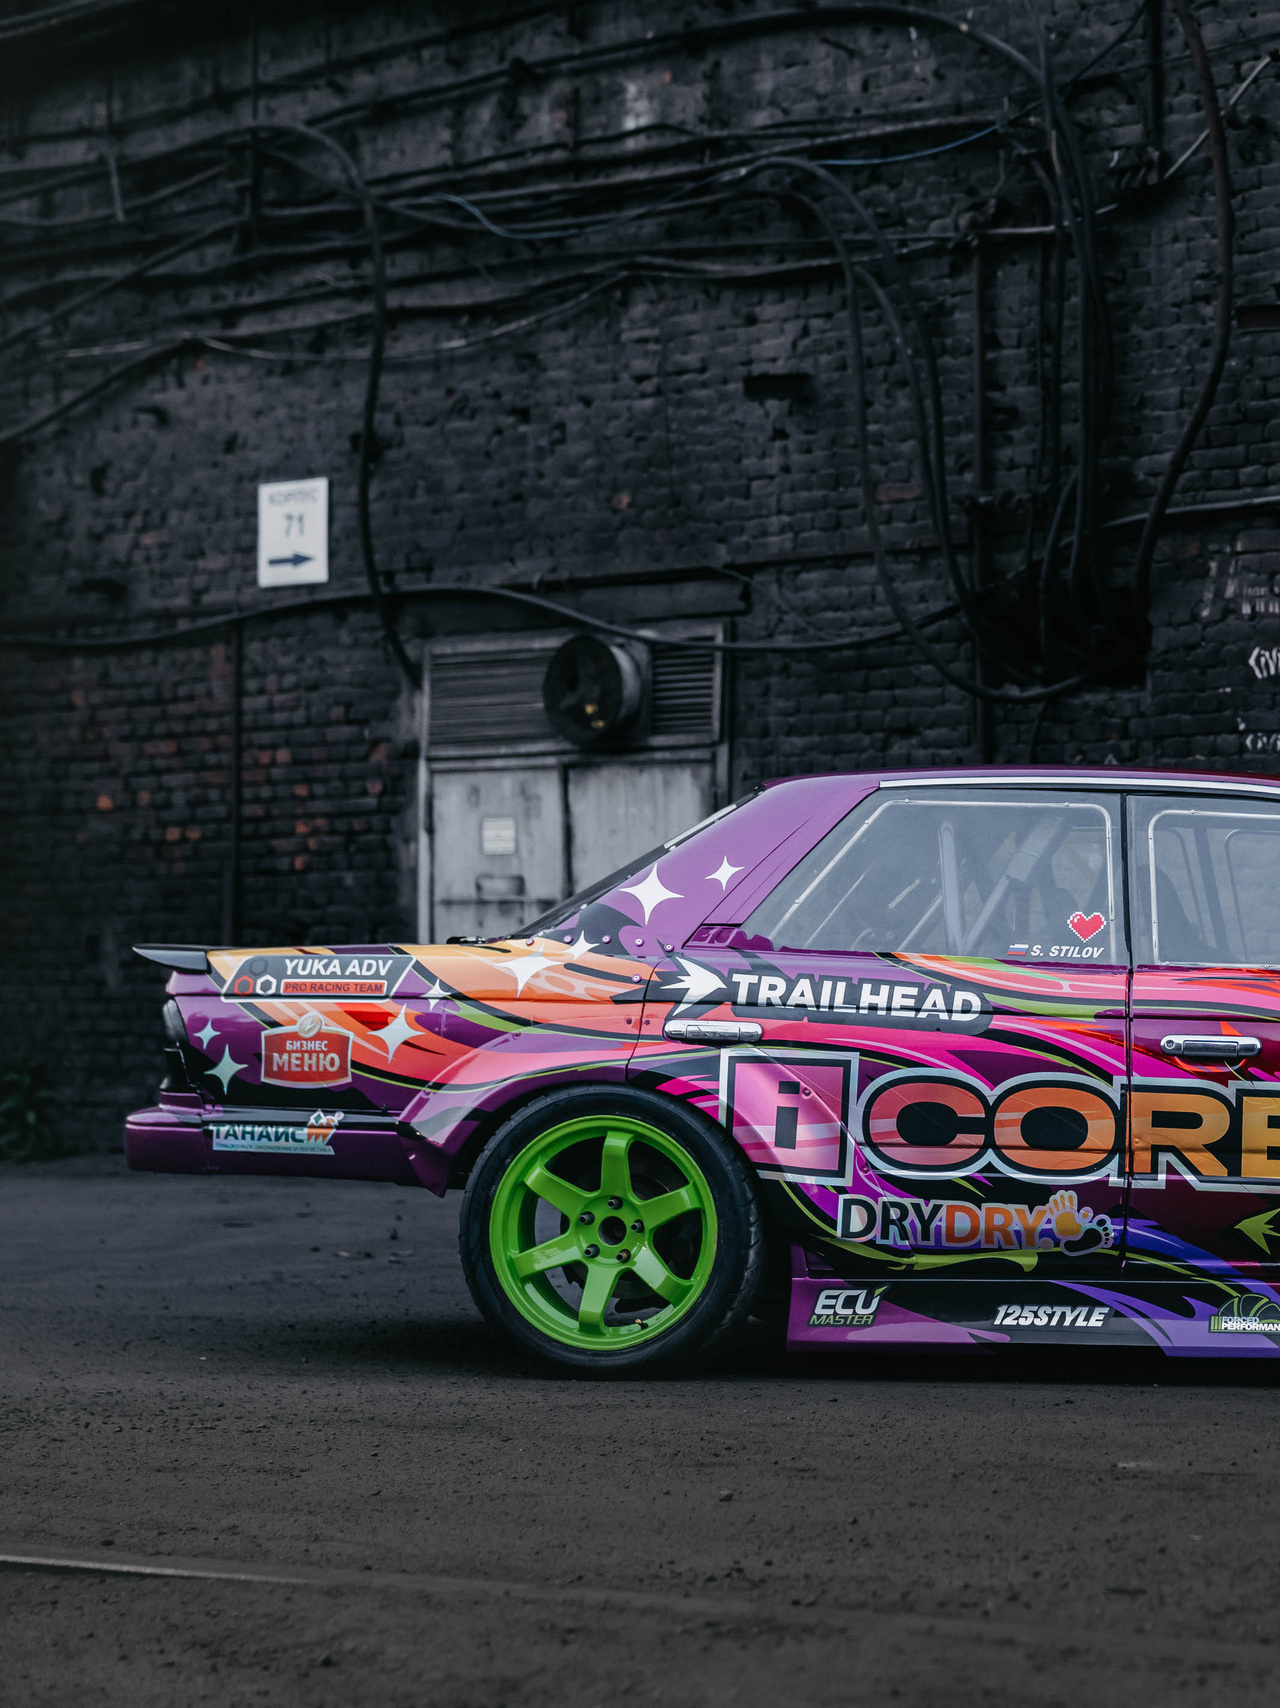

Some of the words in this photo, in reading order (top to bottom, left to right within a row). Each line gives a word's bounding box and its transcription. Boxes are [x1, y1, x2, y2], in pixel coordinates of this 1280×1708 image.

[1031, 944, 1044, 957] S.
[1049, 945, 1104, 959] STILOV
[285, 958, 342, 976] YUKA
[345, 959, 393, 976] ADV
[285, 981, 306, 993] PRO
[310, 981, 351, 993] RACING
[354, 982, 383, 993] TEAM
[731, 973, 982, 1022] TRAILHEAD
[286, 1040, 329, 1051] БИЗНЕС
[272, 1052, 340, 1072] МЕНЮ
[209, 1123, 305, 1143] ТАНАИС
[814, 1288, 884, 1315] ECU
[809, 1314, 874, 1325] MASTER
[993, 1305, 1110, 1327] 125STYLE
[1222, 1316, 1260, 1324] FORCED
